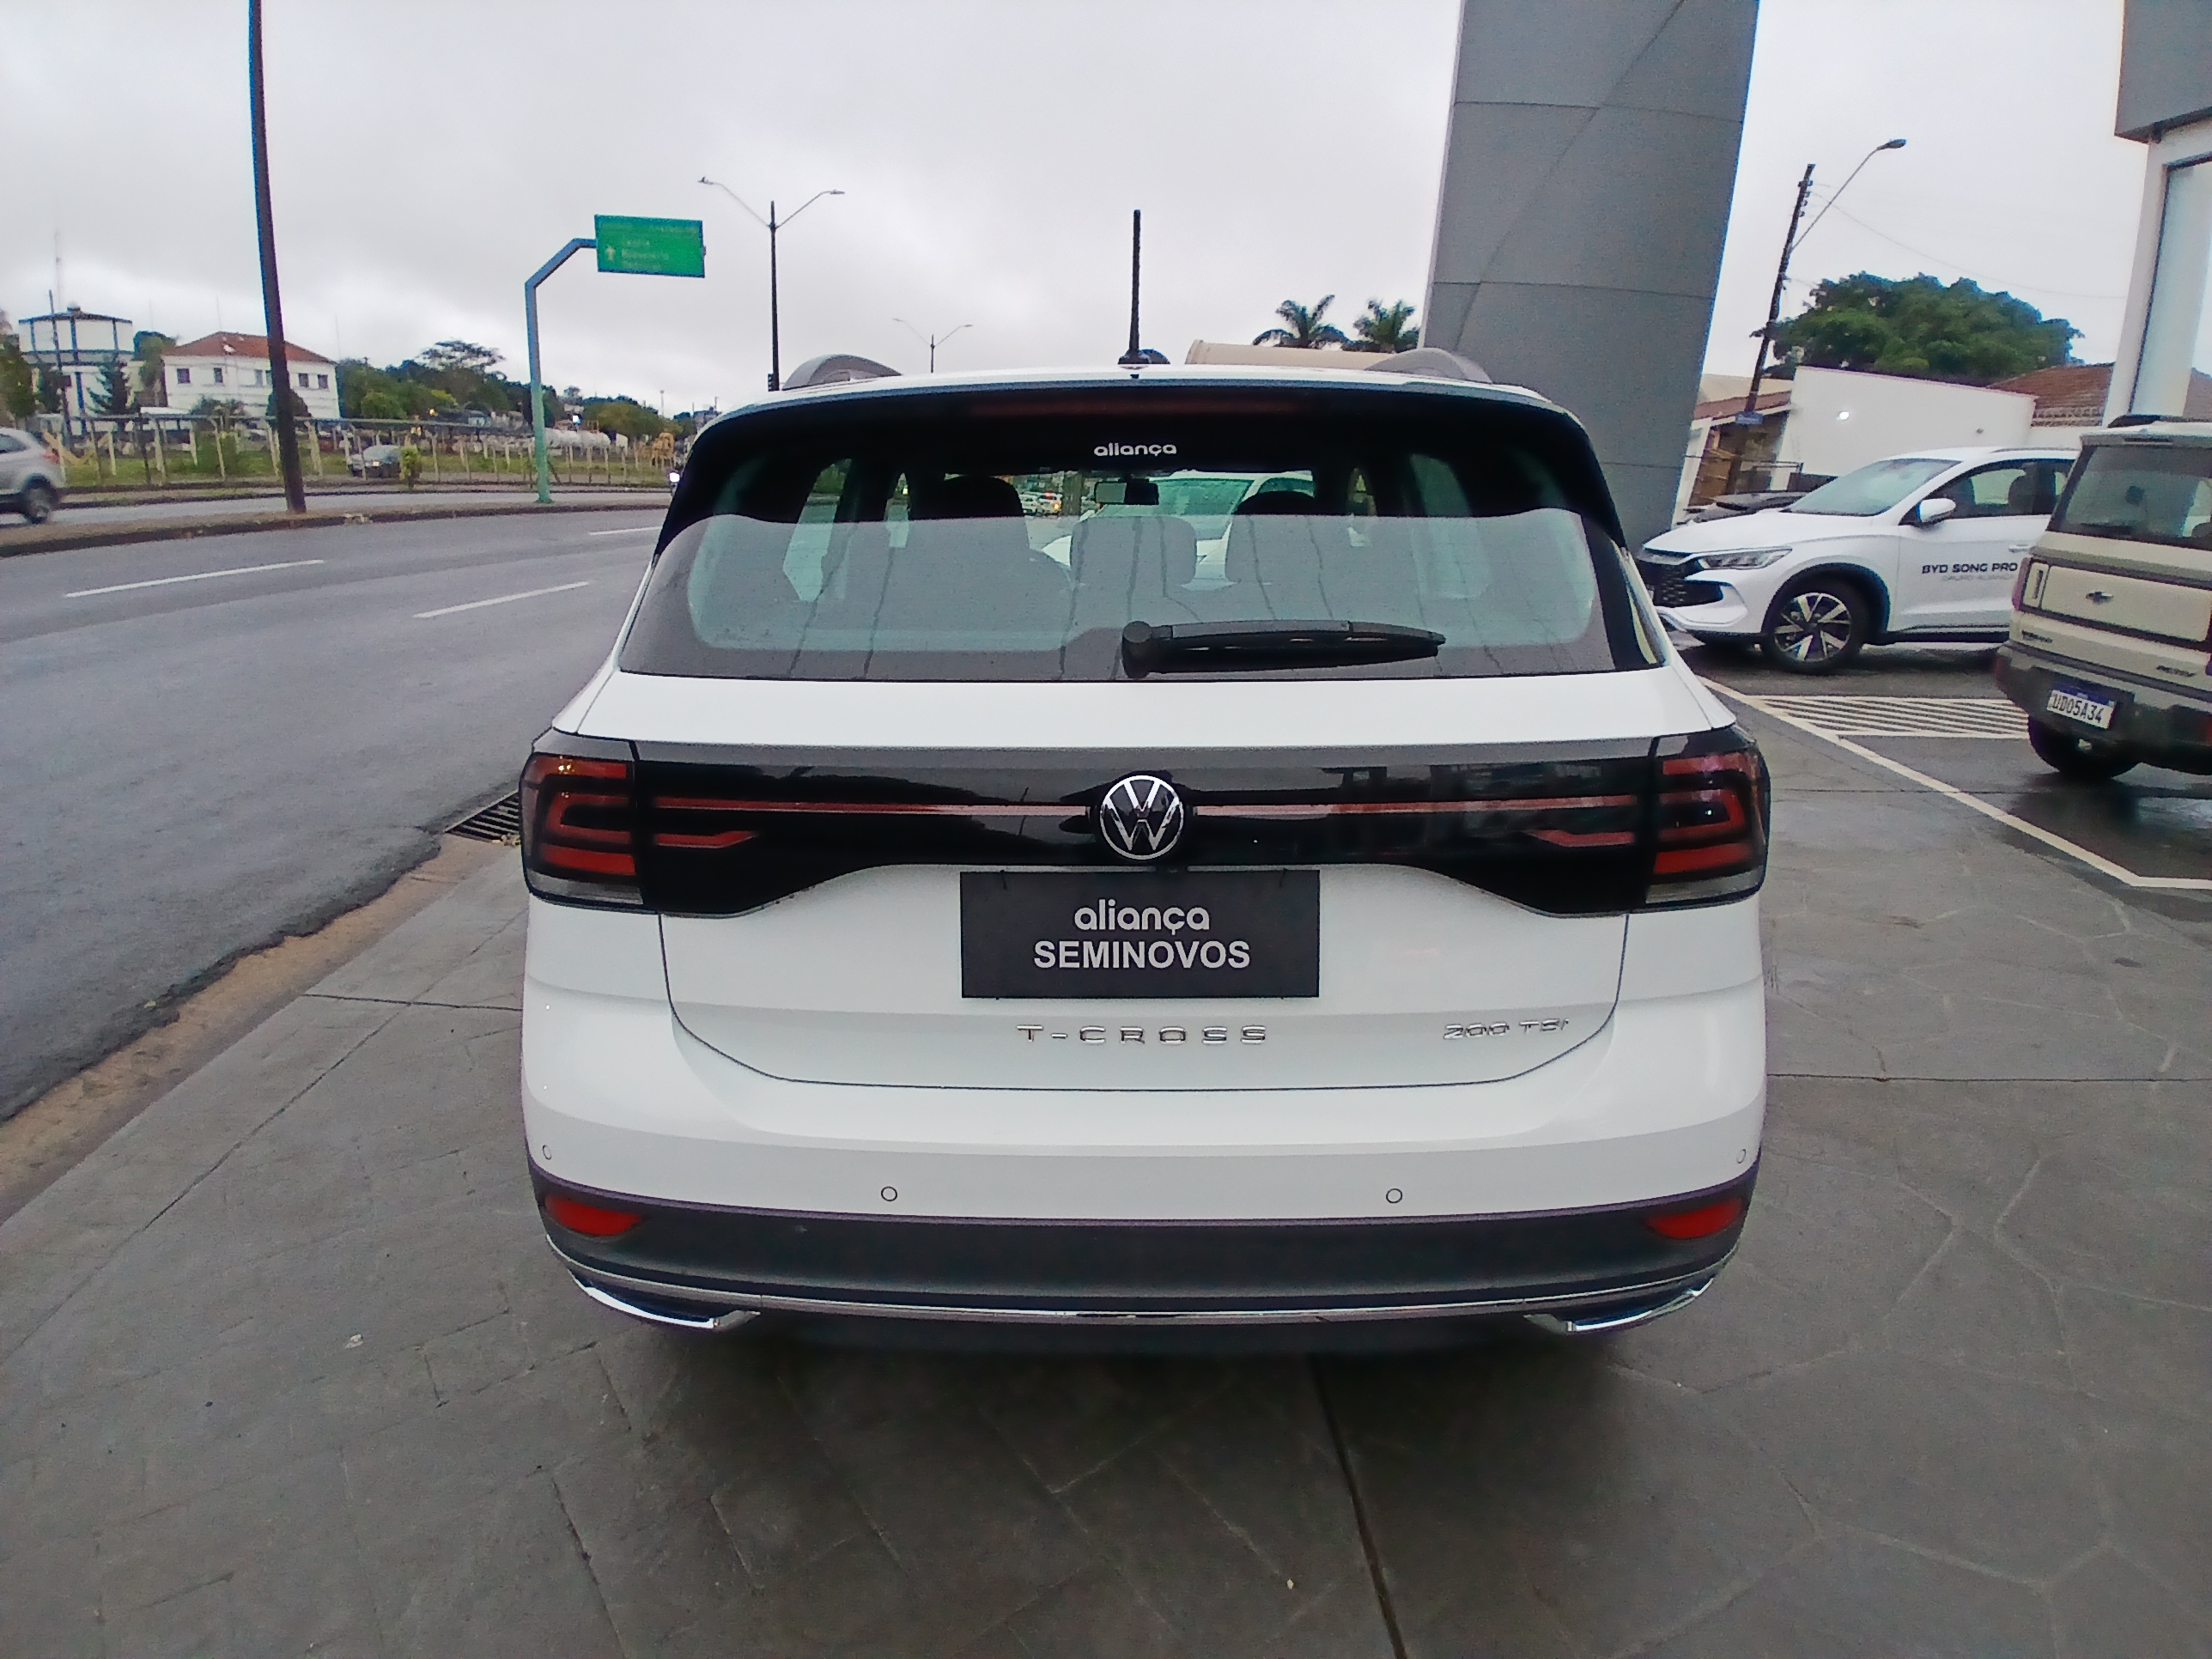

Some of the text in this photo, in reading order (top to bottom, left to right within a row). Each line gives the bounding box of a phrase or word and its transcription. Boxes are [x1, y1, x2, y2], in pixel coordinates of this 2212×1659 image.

[1093, 442, 1177, 457] aliança
[1922, 562, 2018, 574] BYD SONG PRO
[1074, 898, 1210, 936] aliança
[1034, 940, 1250, 969] SEMINOVOS
[1017, 1024, 1267, 1045] T-CROSS
[1443, 1021, 1510, 1040] 200
